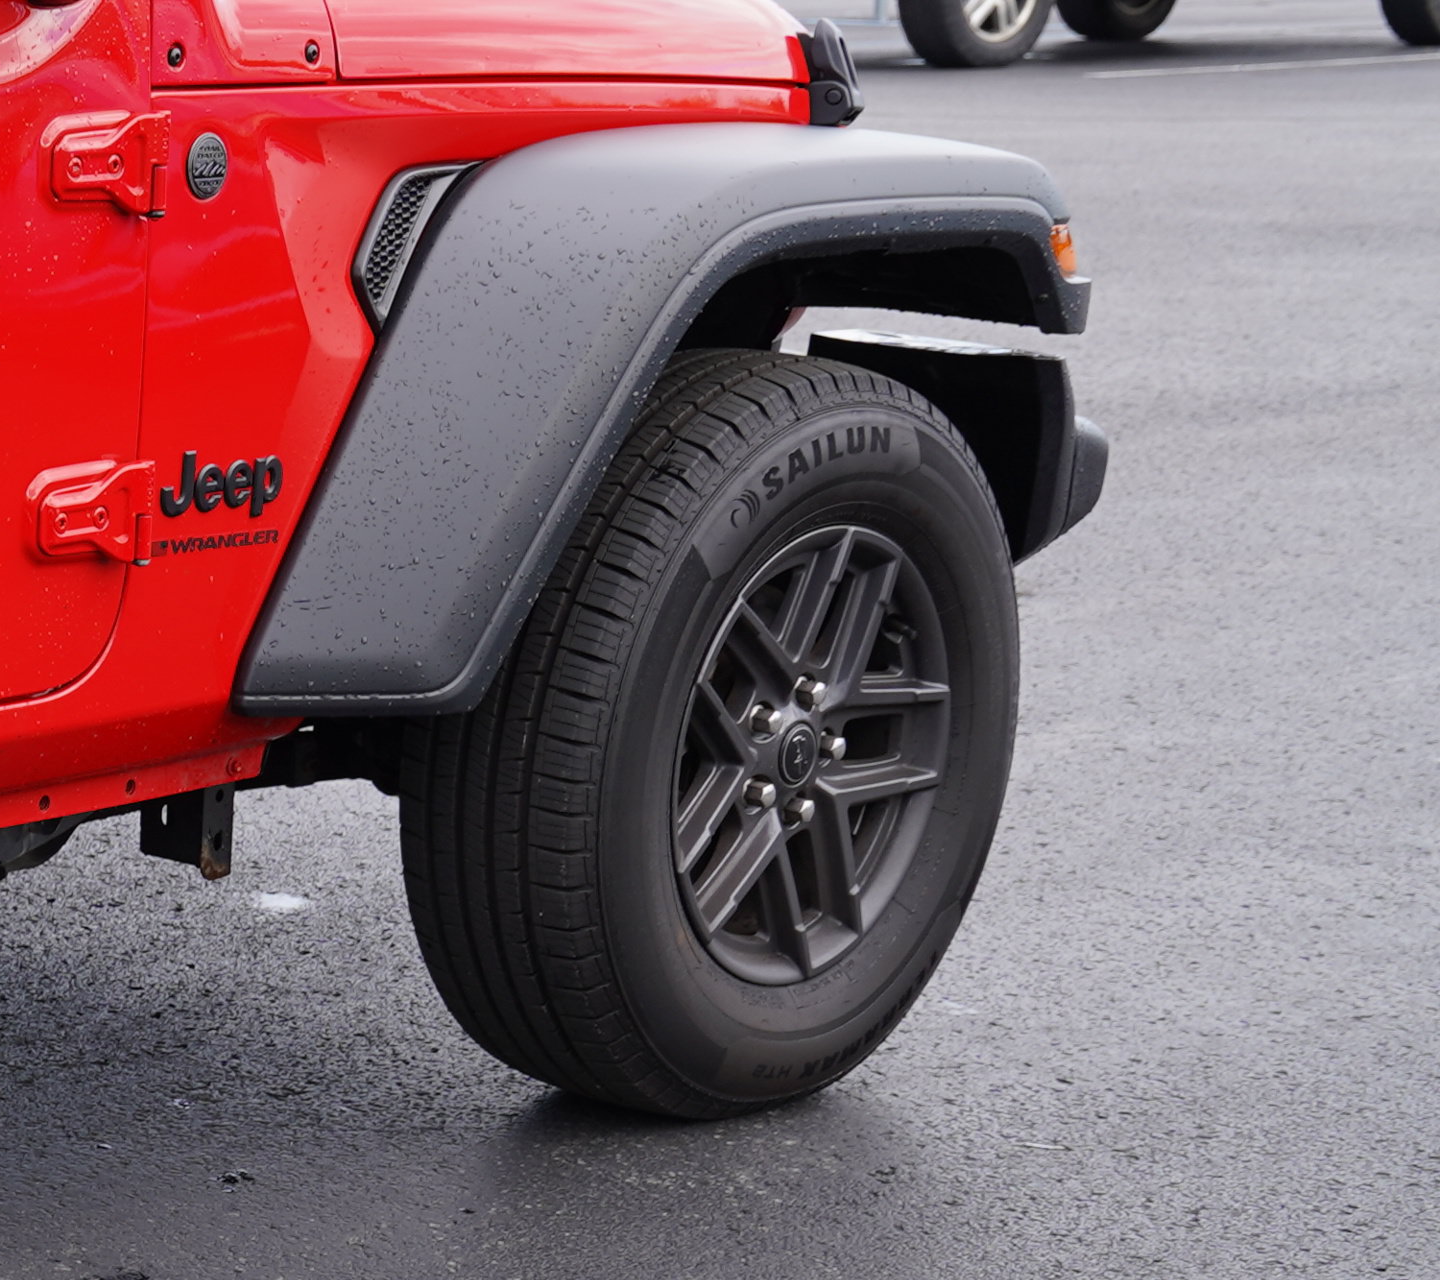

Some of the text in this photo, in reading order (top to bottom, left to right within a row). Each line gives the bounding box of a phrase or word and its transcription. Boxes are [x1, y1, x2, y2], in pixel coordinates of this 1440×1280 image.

[159, 450, 283, 519] Jeep
[761, 425, 891, 501] SAILUN
[170, 529, 279, 554] WRANGLER
